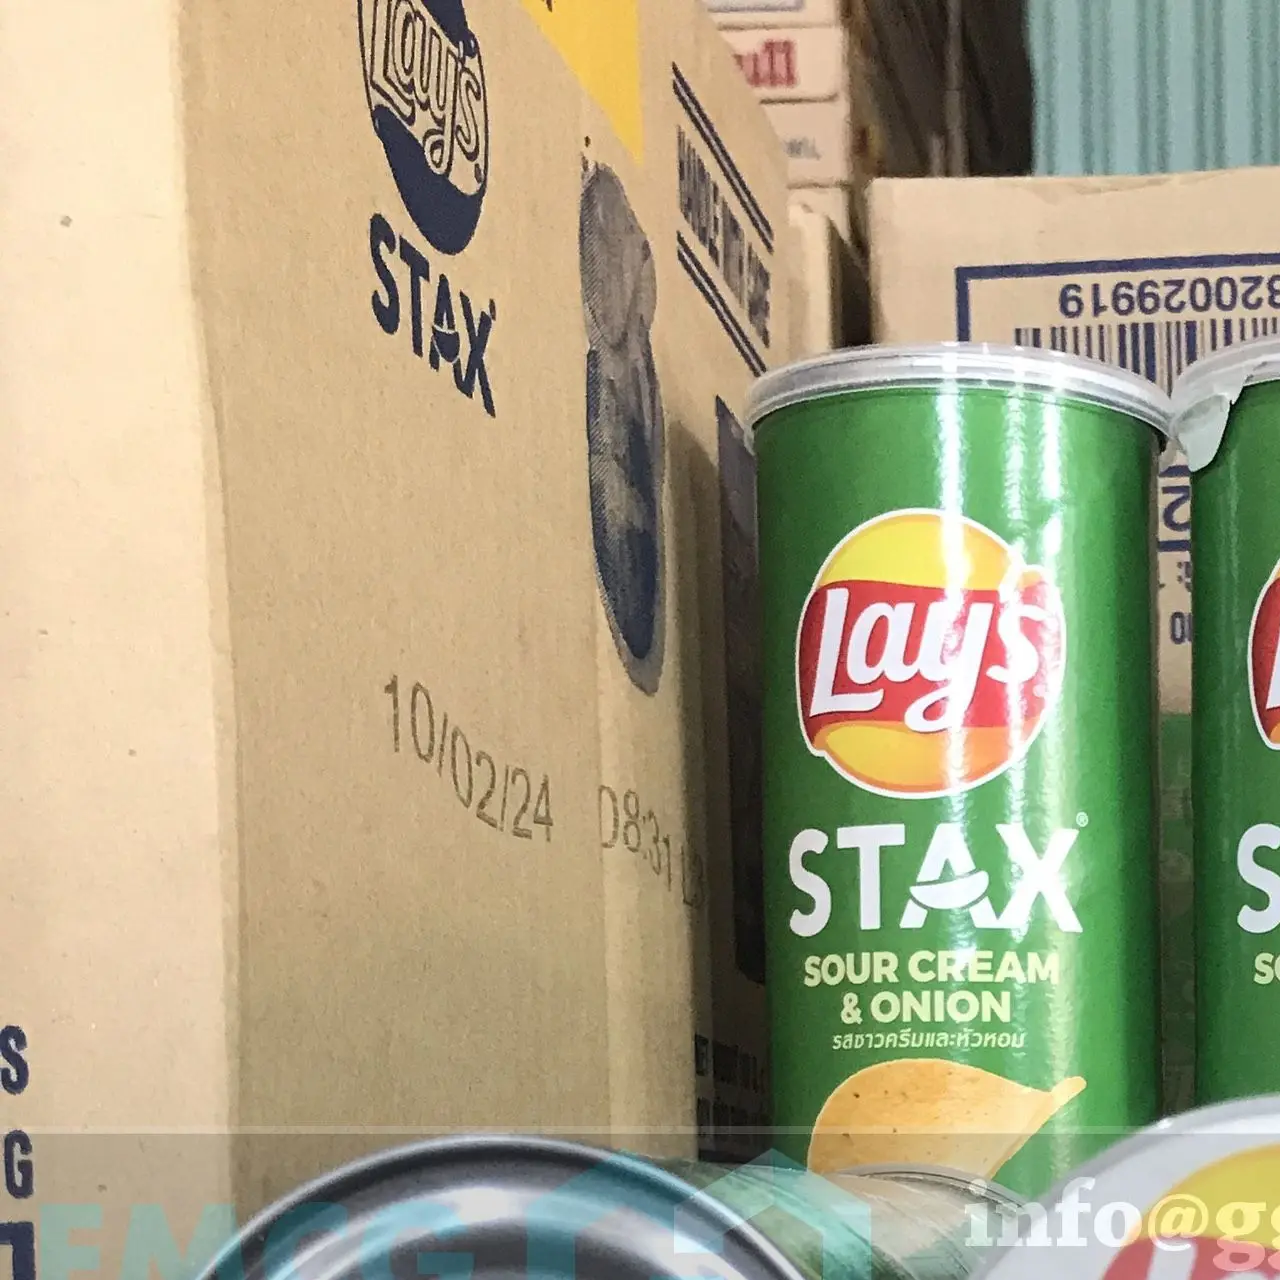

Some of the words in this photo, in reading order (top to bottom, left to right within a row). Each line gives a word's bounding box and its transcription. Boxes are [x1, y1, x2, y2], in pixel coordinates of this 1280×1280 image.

[370, 213, 496, 418] STAX
[809, 570, 1041, 732] Lay's
[384, 674, 554, 843] 10/02/24
[789, 823, 1084, 937] STAX
[804, 952, 899, 987] SOUR
[908, 950, 1060, 986] CREAM
[840, 993, 863, 1026] &
[870, 990, 1011, 1024] ONION
